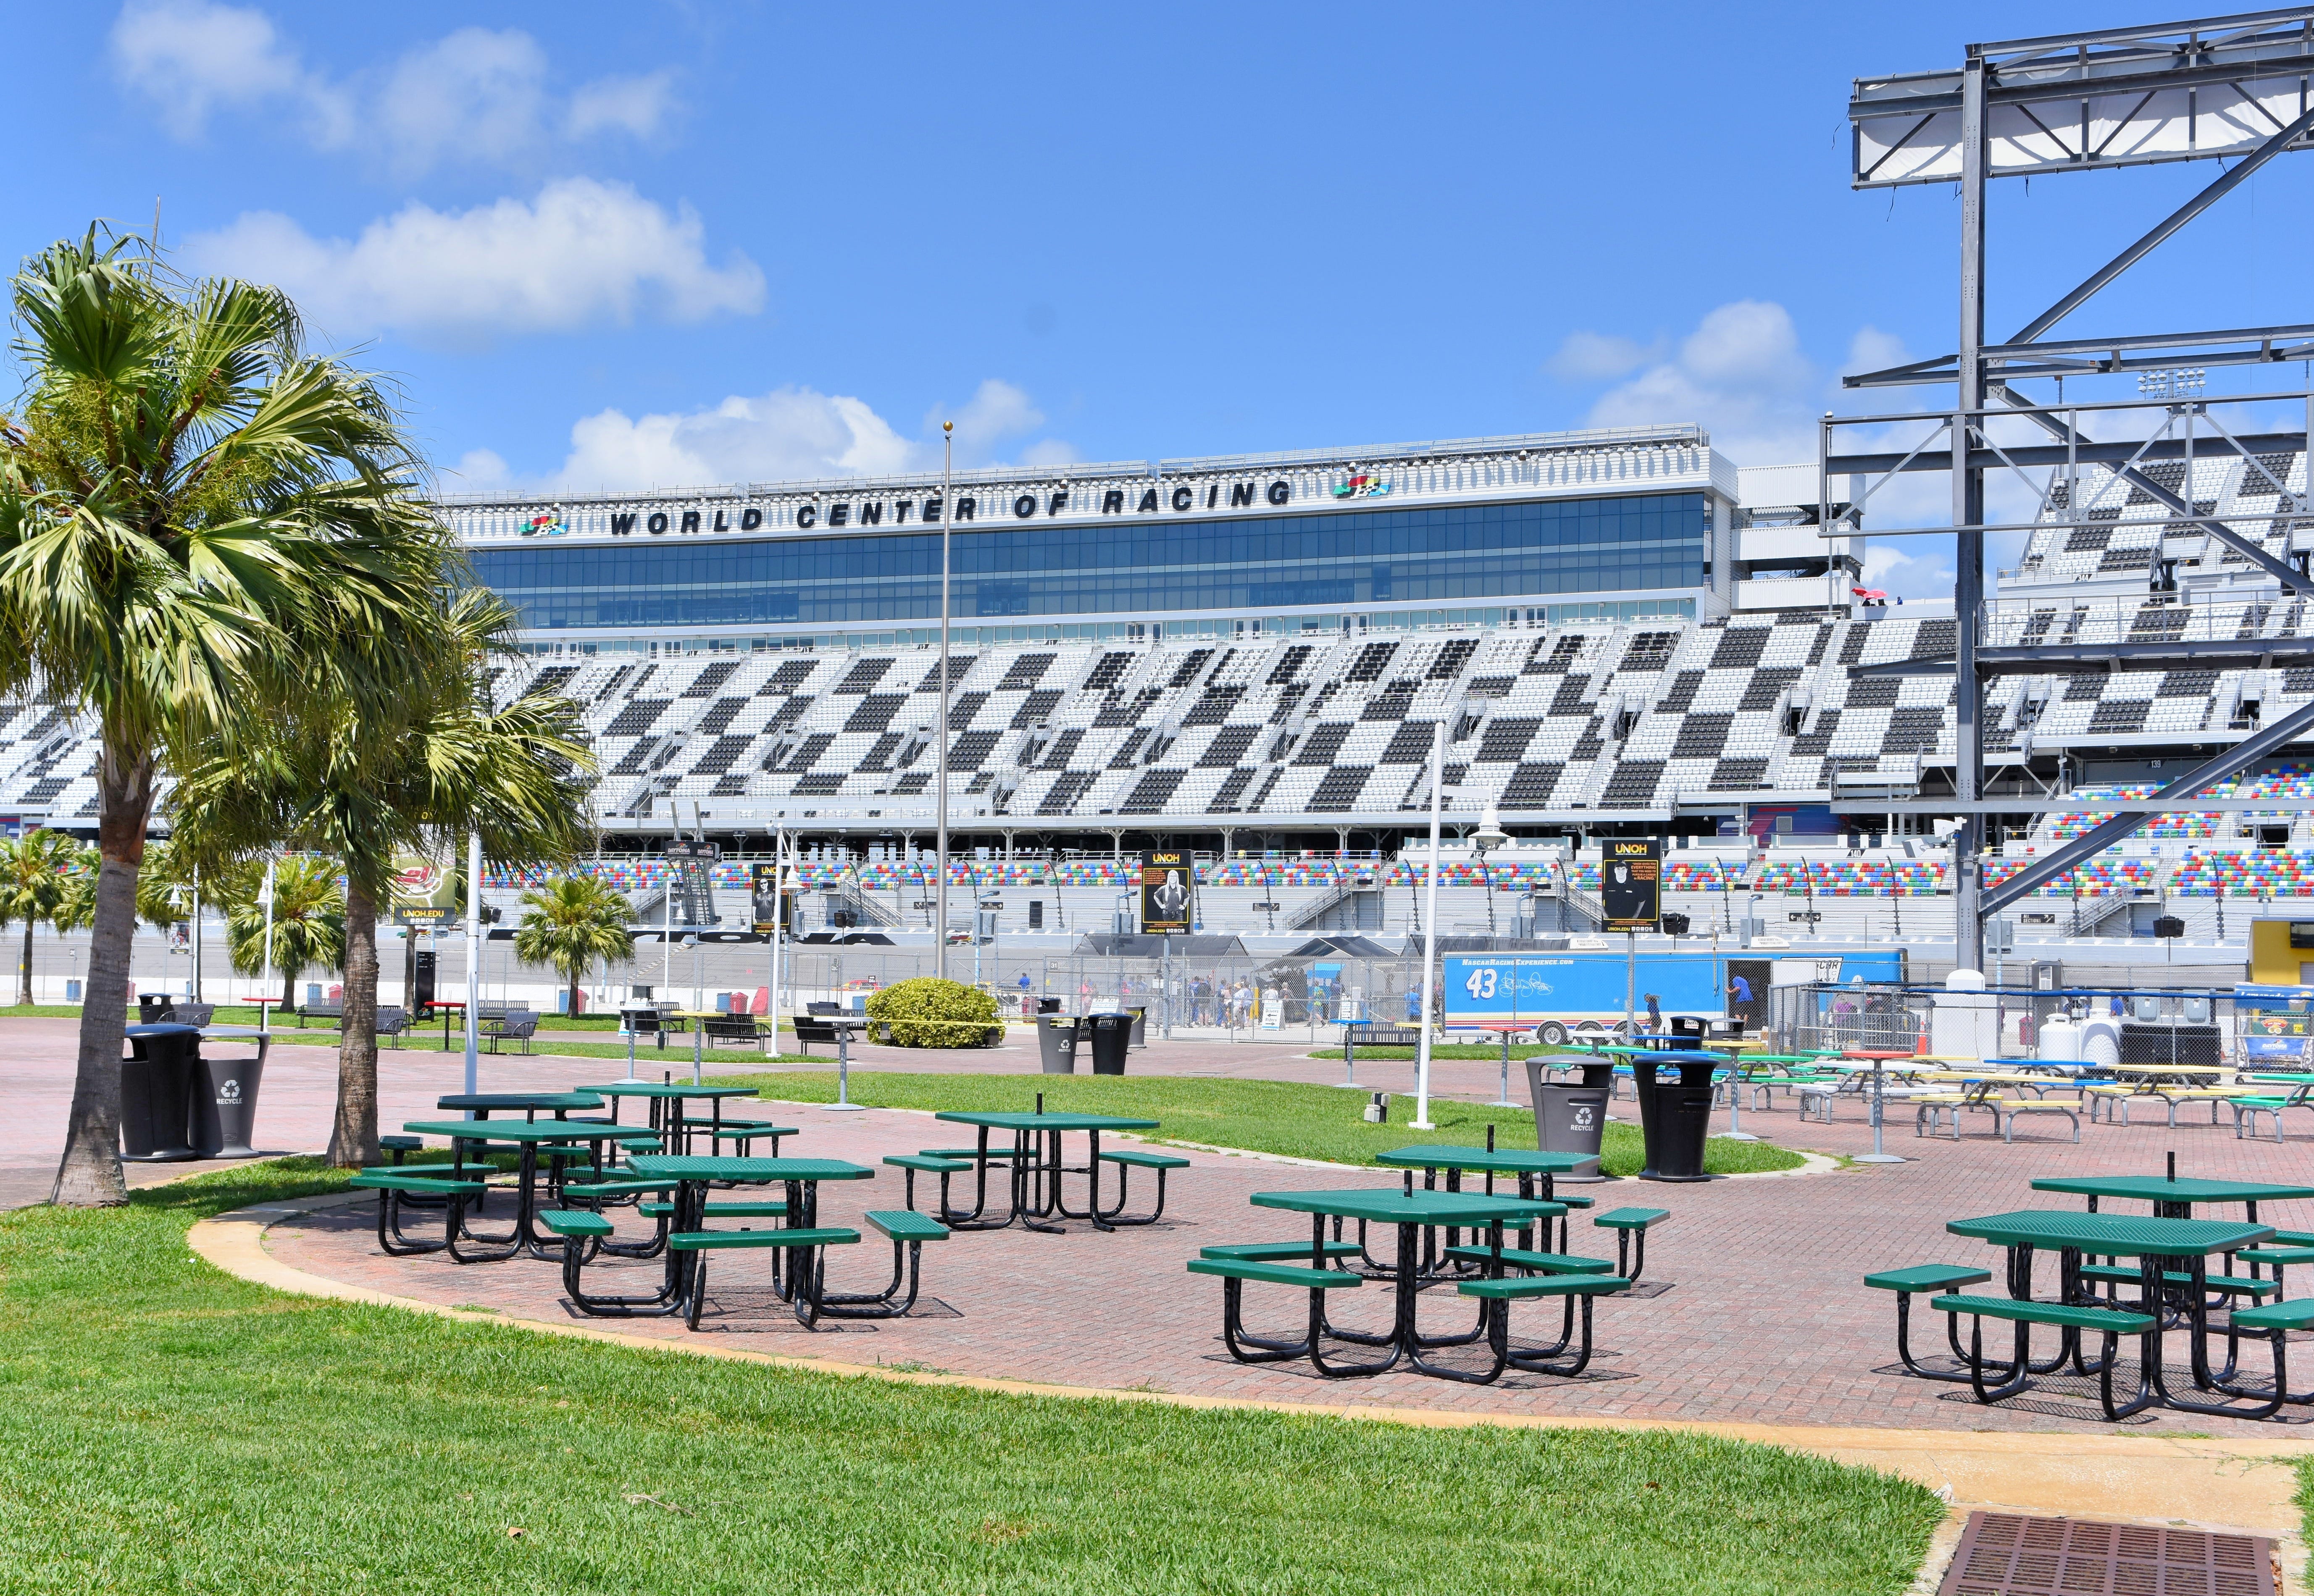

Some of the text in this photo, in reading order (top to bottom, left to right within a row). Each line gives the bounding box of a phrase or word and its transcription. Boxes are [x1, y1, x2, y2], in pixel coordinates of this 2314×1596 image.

[611, 481, 1290, 534] WORLD CENTER OF RACING
[1153, 852, 1180, 862] UNOH
[1615, 843, 1647, 853] UNOH
[1465, 968, 1497, 1000] 43
